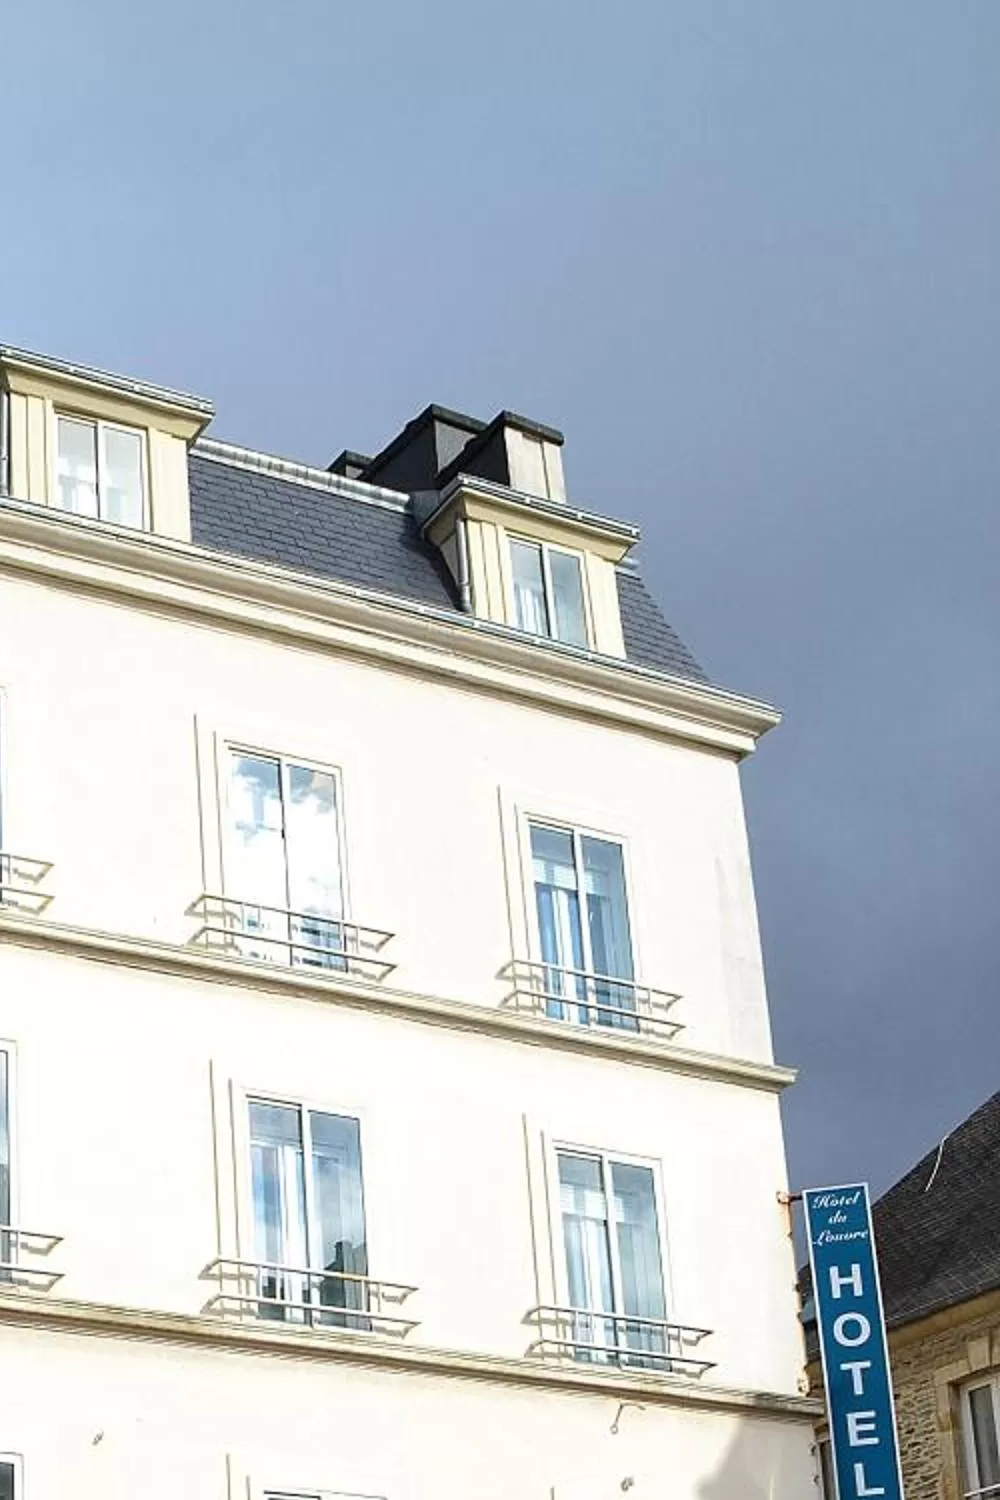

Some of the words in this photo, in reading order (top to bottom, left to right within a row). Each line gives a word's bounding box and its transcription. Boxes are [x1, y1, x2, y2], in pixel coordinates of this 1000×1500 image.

[828, 1210, 847, 1225] du
[813, 1229, 868, 1246] Louvre
[829, 1263, 885, 1498] HOTEL
